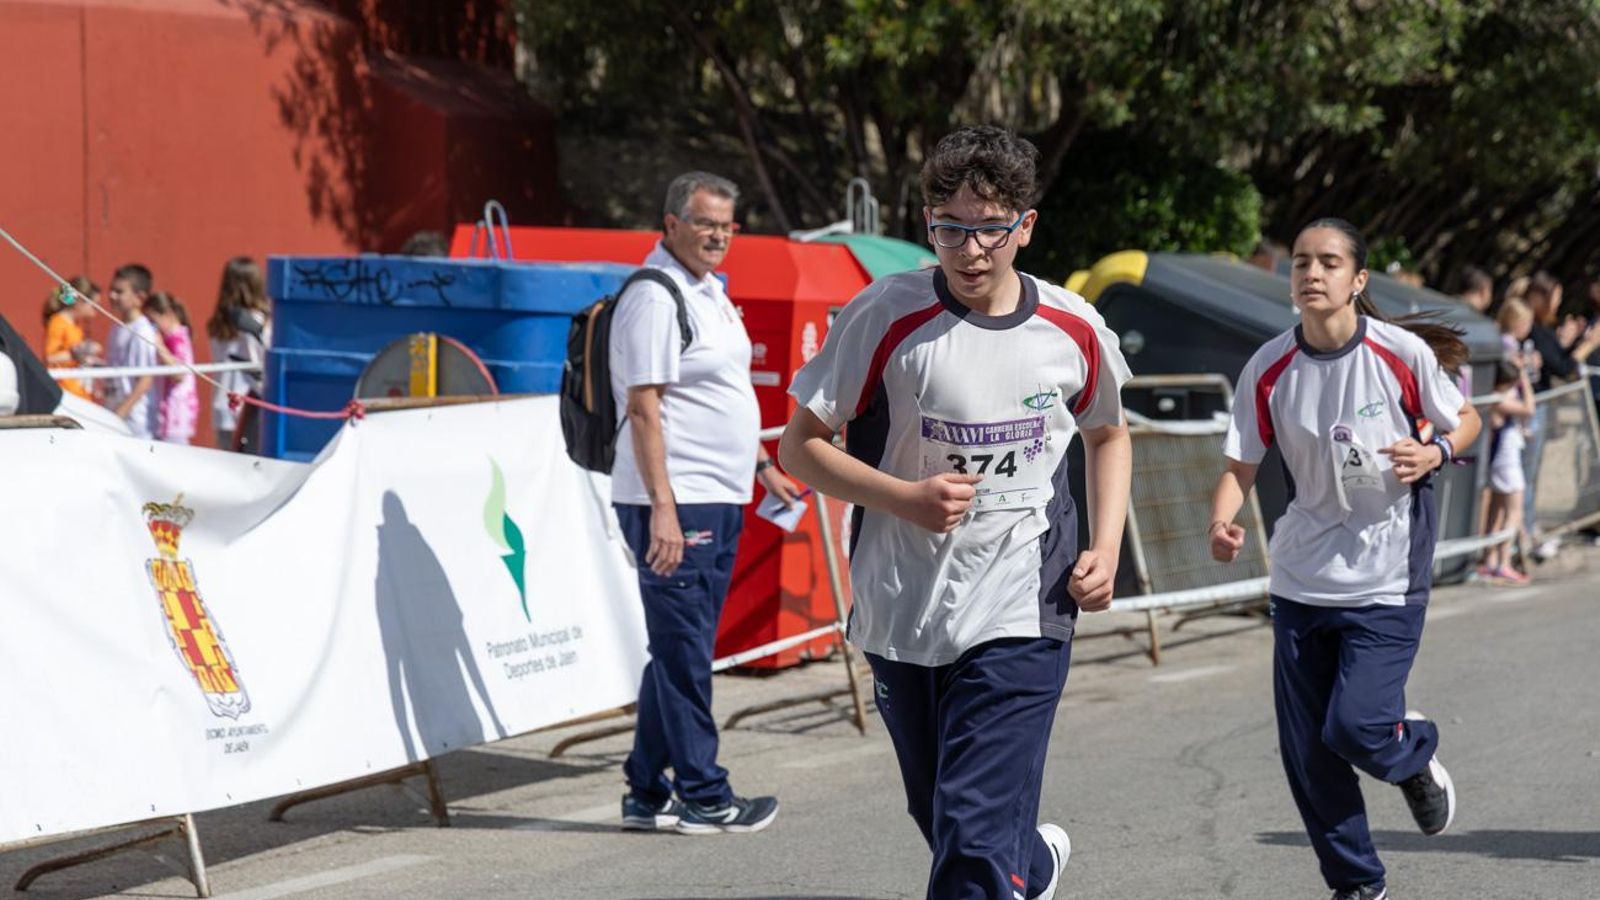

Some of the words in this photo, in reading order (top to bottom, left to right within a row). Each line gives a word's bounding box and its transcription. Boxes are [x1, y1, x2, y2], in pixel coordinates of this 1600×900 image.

[985, 424, 1014, 434] CARRERA
[990, 433, 1000, 442] LA
[1005, 429, 1032, 440] GLORIA
[946, 450, 1017, 477] 374
